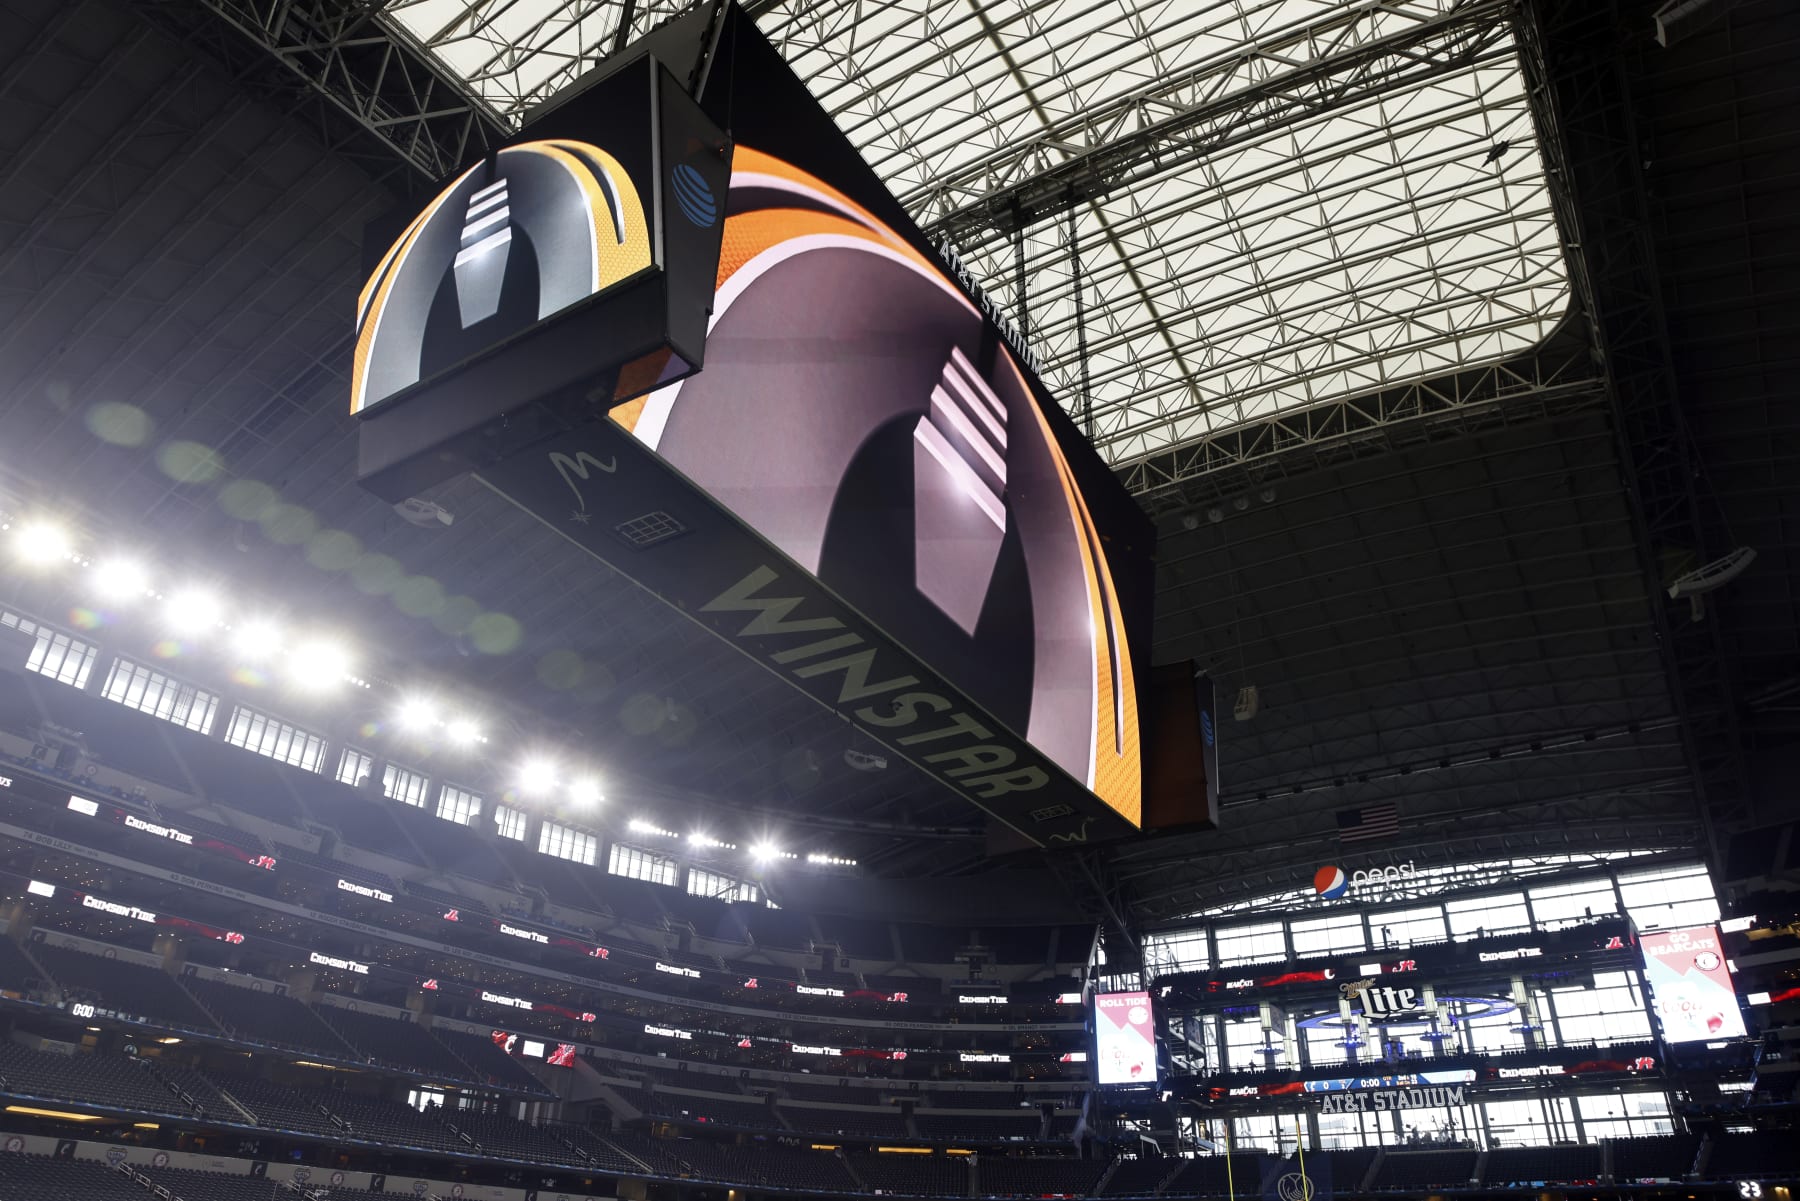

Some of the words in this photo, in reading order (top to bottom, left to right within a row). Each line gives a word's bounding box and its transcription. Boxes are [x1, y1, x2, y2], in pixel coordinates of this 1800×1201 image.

[938, 240, 980, 297] AT&T
[981, 289, 1043, 380] STADIUM
[698, 564, 1050, 799] WINSTAR
[125, 815, 170, 838] CRIMSON
[169, 828, 193, 845] TIDE
[1352, 860, 1416, 892] pepsi
[83, 895, 131, 917] CRIMSON
[131, 907, 156, 923] TIDE
[1649, 938, 1715, 956] BEARCATS
[1669, 932, 1690, 944] GO
[1099, 999, 1124, 1008] ROLL
[1125, 997, 1147, 1006] TIDE
[1355, 986, 1417, 1020] Lite
[1229, 1085, 1258, 1096] BEARCATS
[1360, 1078, 1380, 1088] 0:00
[1321, 1092, 1369, 1114] AT&T
[1373, 1086, 1467, 1111] STADIUM
